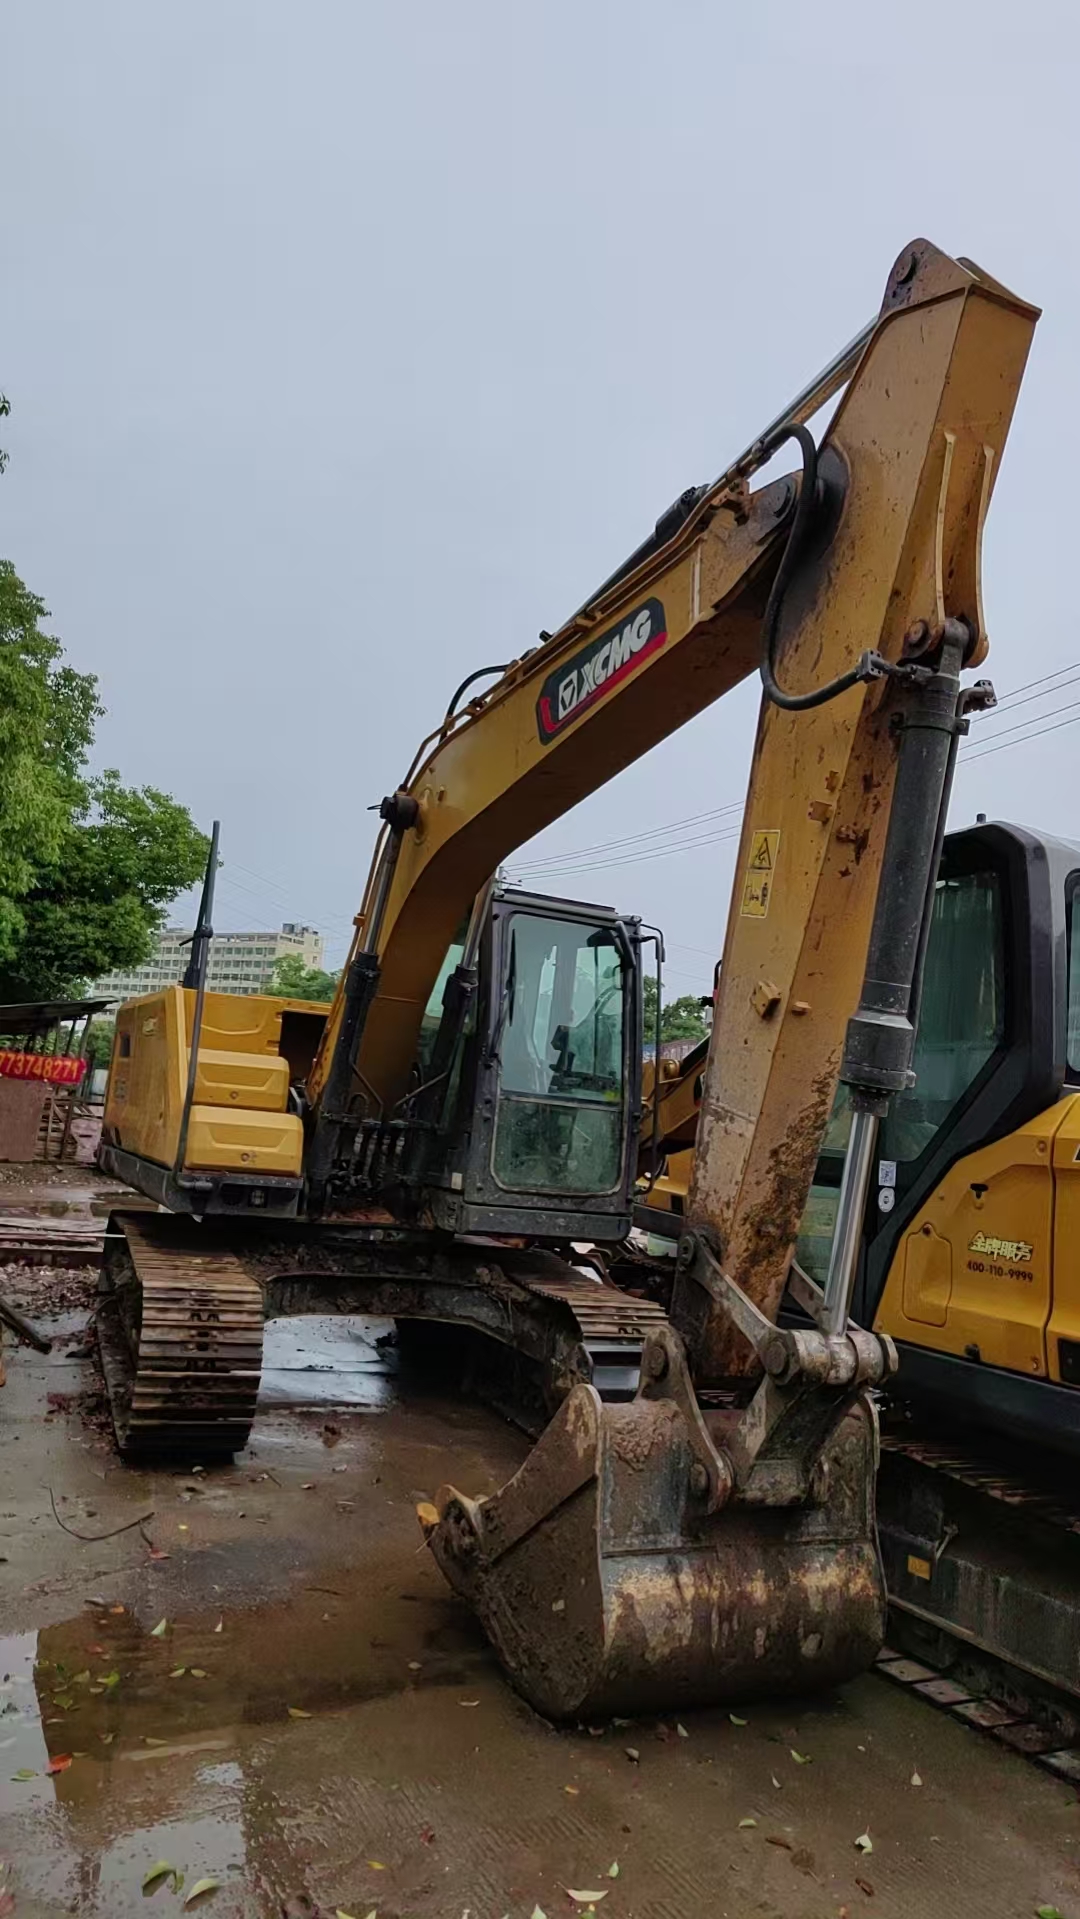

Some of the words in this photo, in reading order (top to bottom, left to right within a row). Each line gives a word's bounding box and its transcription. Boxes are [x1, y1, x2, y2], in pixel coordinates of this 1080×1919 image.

[577, 609, 652, 705] XCMG
[968, 1231, 1033, 1262] 金牌服务
[967, 1260, 1033, 1282] 400-110-9999
